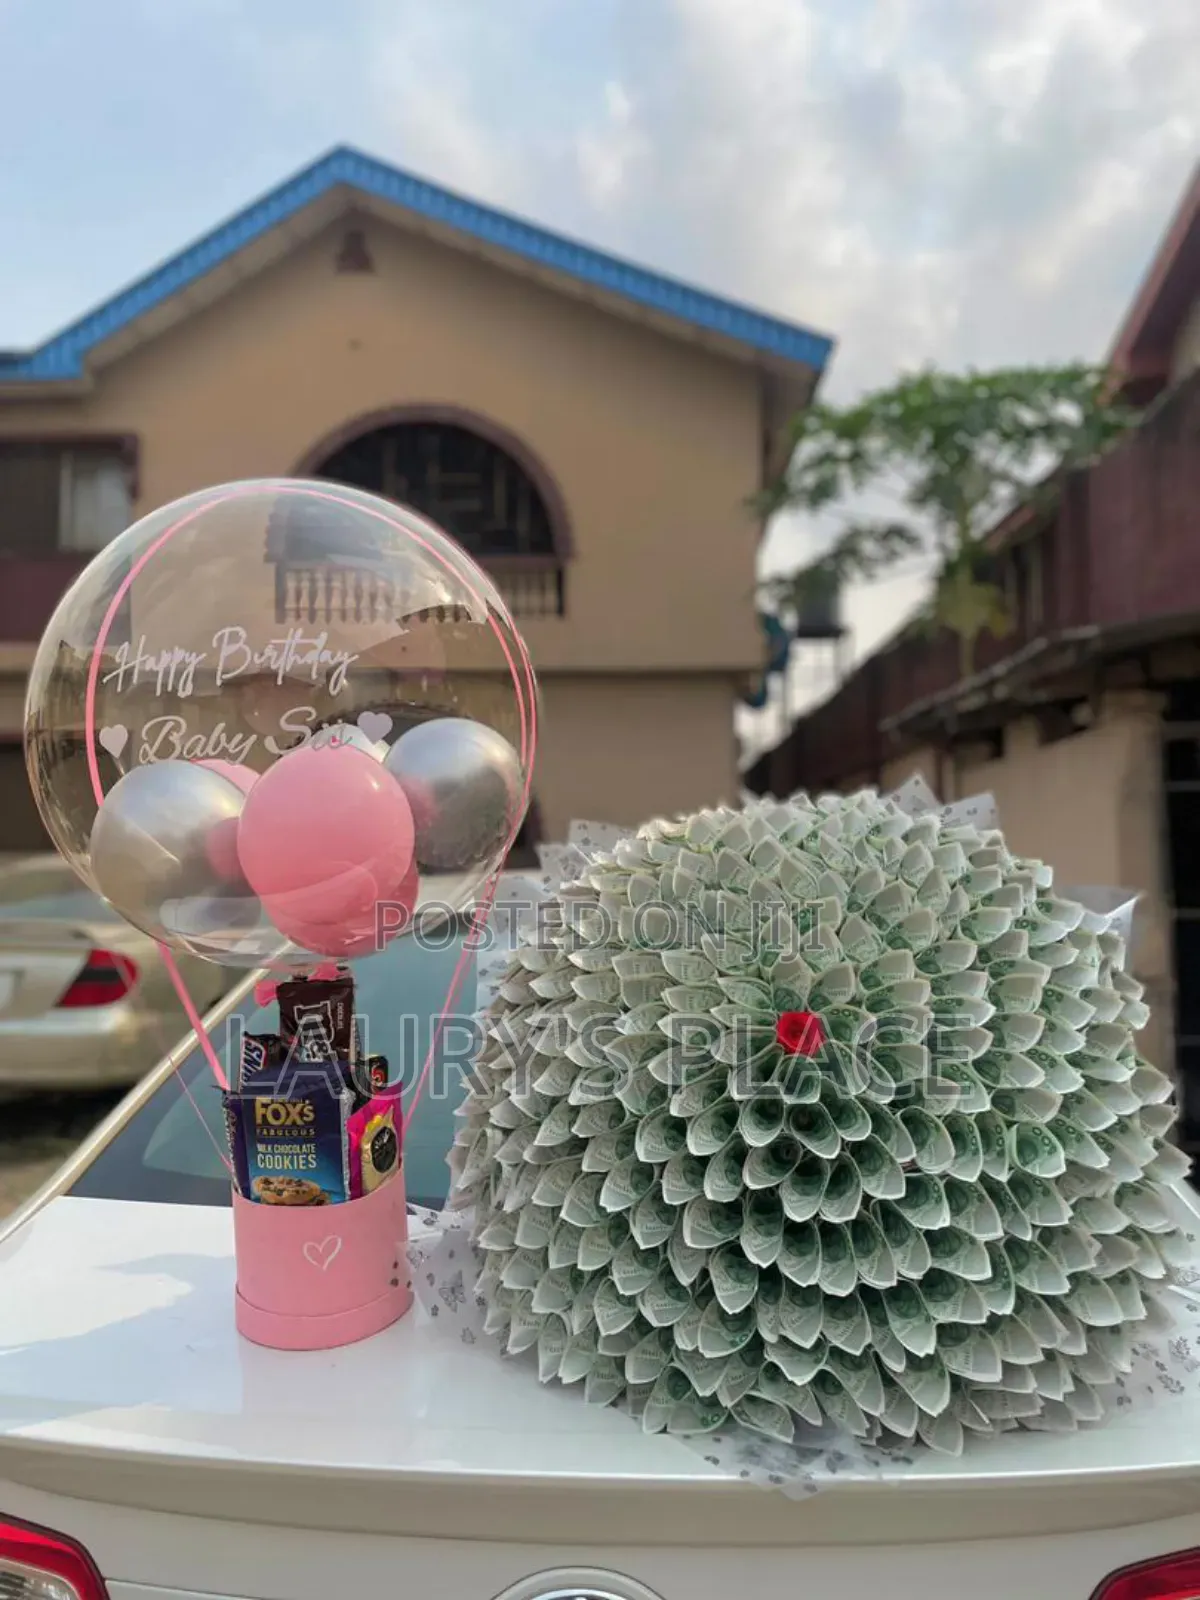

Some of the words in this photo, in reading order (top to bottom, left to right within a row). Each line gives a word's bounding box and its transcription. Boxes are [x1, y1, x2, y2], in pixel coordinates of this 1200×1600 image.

[100, 634, 207, 698] Happy
[212, 626, 359, 696] Birthday
[138, 715, 258, 766] Baby
[257, 1153, 318, 1169] COOKIES
[273, 1144, 316, 1154] CHOCOLATE
